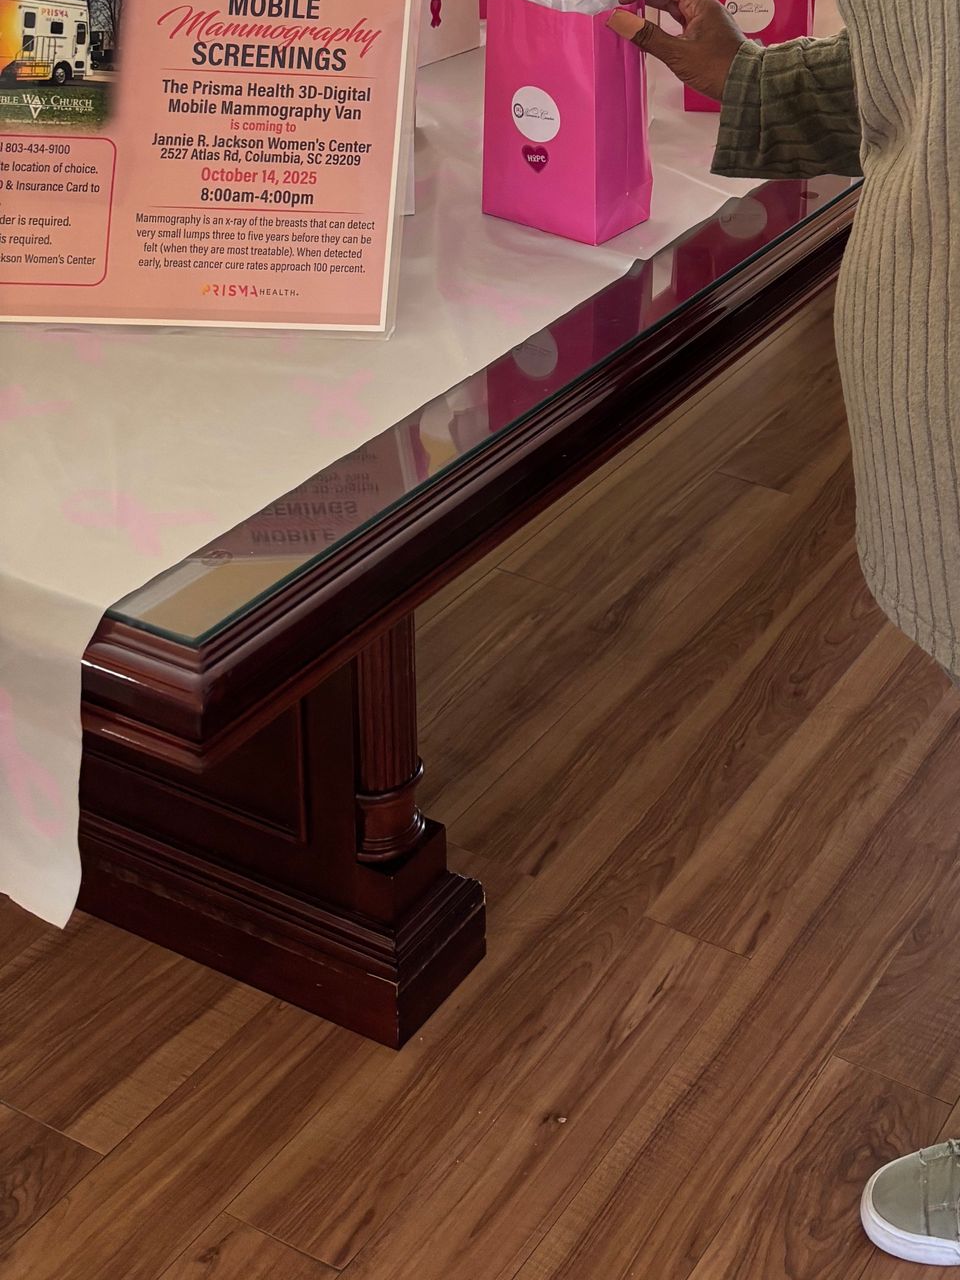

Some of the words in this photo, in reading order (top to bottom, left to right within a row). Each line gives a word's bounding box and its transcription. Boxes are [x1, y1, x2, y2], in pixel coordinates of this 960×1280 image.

[157, 5, 382, 58] Mammography
[191, 41, 347, 71] SCREENINGS
[162, 79, 188, 94] The
[192, 81, 243, 96] Prisma
[247, 83, 294, 99] Health
[298, 85, 371, 104] 3D-Digital
[168, 98, 217, 114] Mobile
[221, 100, 331, 121] Mammography
[335, 105, 362, 120] Van
[230, 119, 240, 130] is
[242, 120, 283, 134] coming
[285, 121, 297, 132] to
[5, 143, 70, 155] 803-434-9100
[152, 133, 194, 147] Jannie
[197, 135, 210, 147] R.
[212, 135, 264, 149] Jackson
[267, 137, 325, 152] Women's
[328, 140, 373, 154] Center
[160, 147, 188, 160] 2527
[191, 148, 220, 161] Atlas
[223, 150, 242, 163] Rd,
[245, 150, 304, 165] Columbia,
[307, 153, 323, 165] SC
[325, 154, 361, 166] 29209
[12, 161, 50, 173] location
[53, 163, 63, 173] of
[64, 163, 98, 174] choice.
[201, 167, 258, 183] October
[262, 169, 280, 186] 14,
[283, 170, 317, 185] 2025
[6, 180, 13, 190] &
[16, 181, 64, 192] Insurance
[66, 182, 88, 193] Card
[91, 184, 100, 193] to
[200, 188, 314, 207] 8:00am-4:00pm
[18, 215, 26, 225] is
[28, 216, 71, 228] required.
[136, 213, 201, 226] Mammography
[203, 214, 211, 224] is
[212, 217, 224, 225] an
[225, 218, 247, 228] x-ray
[249, 216, 258, 226] of
[260, 217, 274, 227] the
[275, 217, 308, 228] breasts
[310, 218, 327, 229] that
[329, 220, 346, 229] can
[347, 220, 375, 230] detect
[9, 234, 52, 246] required.
[136, 230, 156, 239] very
[158, 229, 182, 239] small
[183, 229, 210, 241] lumps
[212, 230, 235, 240] three
[237, 232, 246, 240] to
[248, 231, 264, 241] five
[265, 233, 289, 243] years
[291, 232, 320, 243] before
[321, 234, 341, 245] they
[342, 236, 358, 244] can
[360, 235, 372, 245] be
[144, 242, 158, 252] felt
[160, 242, 187, 254] (when
[189, 244, 209, 256] they
[210, 246, 225, 254] are
[226, 246, 249, 255] most
[250, 247, 295, 258] treatable).
[296, 247, 321, 258] When
[323, 248, 363, 258] detected
[24, 254, 65, 265] Women's
[66, 255, 96, 265] Center
[138, 257, 161, 269] early,
[163, 258, 191, 268] breast
[193, 260, 223, 269] cancer
[225, 261, 244, 270] cure
[246, 262, 269, 271] rates
[270, 262, 311, 273] approach
[313, 262, 328, 272] 100
[329, 265, 366, 274] percent.
[201, 283, 259, 297] PRISMA
